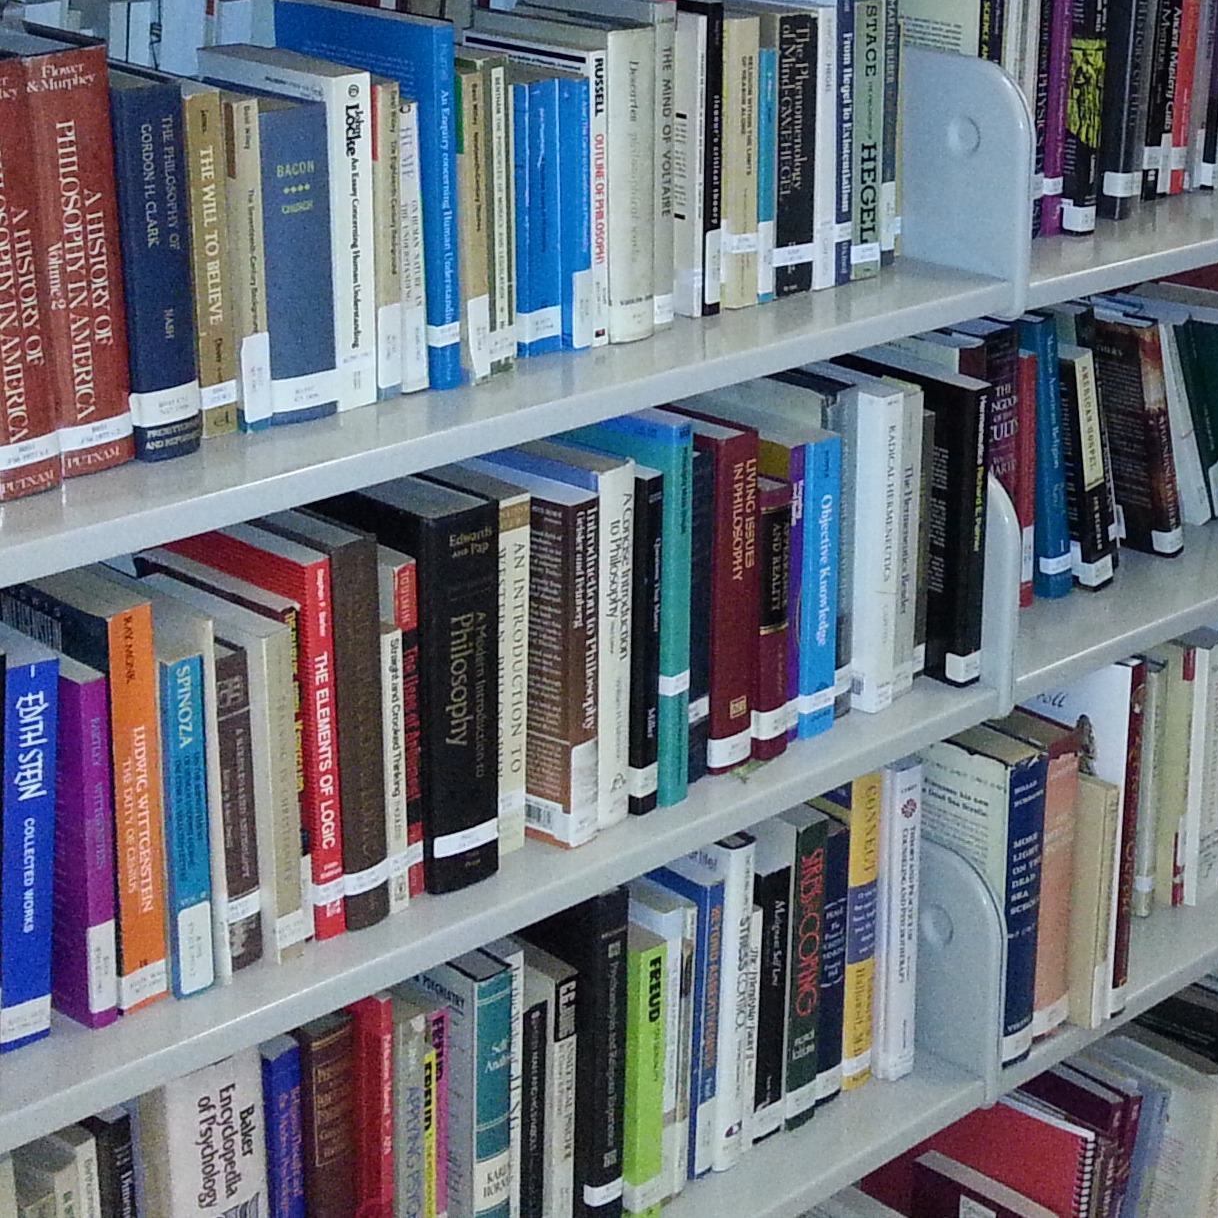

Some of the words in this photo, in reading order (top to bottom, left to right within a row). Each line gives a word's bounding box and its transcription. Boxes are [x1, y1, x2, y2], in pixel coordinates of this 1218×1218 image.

[661, 46, 673, 74] THE
[793, 23, 811, 60] The
[842, 32, 854, 65] From
[864, 4, 880, 77] STACE
[594, 56, 606, 117] RUSSELL
[660, 78, 673, 119] MIND
[841, 68, 854, 105] Hegel
[160, 114, 175, 144] THE
[344, 103, 362, 158] Locke
[660, 123, 673, 145] OF
[790, 61, 811, 191] Phenomenology
[842, 107, 853, 121] To
[140, 123, 156, 183] GORDON
[199, 145, 215, 181] THE
[275, 159, 316, 179] BACON
[349, 157, 361, 171] An
[841, 122, 853, 213] Existentialism
[55, 119, 89, 268] PHILOSOPHY
[84, 188, 102, 205] A
[143, 184, 156, 200] H.
[162, 146, 180, 229] PHILOSOPHY
[201, 182, 217, 229] WILL
[348, 171, 361, 197] Essay
[660, 150, 674, 219] VOLTAIRE
[860, 142, 878, 244] HEGEL
[10, 206, 29, 224] A
[145, 200, 161, 249] CLARK
[349, 197, 362, 249] Concerning
[85, 209, 110, 315] HISTORY
[168, 233, 180, 250] OF
[204, 233, 219, 257] TO
[350, 249, 363, 283] Human
[12, 227, 42, 340] HISTORY
[69, 276, 90, 308] IN
[206, 261, 224, 326] BELIEVE
[94, 321, 114, 346] OF
[350, 284, 364, 350] Understanding
[24, 344, 45, 367] OF
[70, 313, 97, 422] AMERICA
[734, 461, 746, 477] IN
[745, 459, 758, 514] LIVING
[621, 492, 633, 506] A
[608, 519, 621, 538] to
[619, 507, 633, 567] Concise
[732, 483, 746, 583] PHILOSOPHY
[744, 515, 757, 569] ISSUES
[818, 494, 833, 566] Objective
[513, 542, 526, 571] AN
[585, 505, 600, 617] Introduction
[605, 538, 621, 620] Philosophy
[583, 619, 597, 635] to
[617, 568, 632, 661] Introduction
[815, 567, 832, 648] Knowledge
[314, 652, 329, 687] THE
[388, 637, 402, 682] Straight
[444, 614, 474, 747] Philosophy
[511, 578, 526, 737] INTRODUCTION
[174, 665, 193, 749] SPINOZA
[389, 682, 401, 705] and
[582, 637, 598, 731] Philosophy
[17, 690, 49, 748] EDITH
[316, 688, 332, 773] ELEMENTS
[390, 705, 402, 748] Crooked
[13, 748, 48, 802] STEIN
[132, 724, 148, 792] LUDWIG
[391, 749, 404, 798] Thinking
[510, 744, 524, 773] TO
[319, 773, 333, 797] OF
[23, 817, 36, 887] COLLECTED
[320, 800, 336, 852] LOGIC
[862, 784, 878, 873] CONNECT
[1013, 832, 1039, 849] MORE
[136, 793, 155, 914] WITTGENSTEIN
[1012, 844, 1040, 863] LIGHT
[22, 889, 36, 935] WORKS
[648, 956, 662, 1023] FREUD
[197, 1095, 217, 1114] of
[238, 1104, 257, 1156] Baker
[195, 1115, 219, 1208] Psychology
[217, 1083, 243, 1199] Encyclopedia
